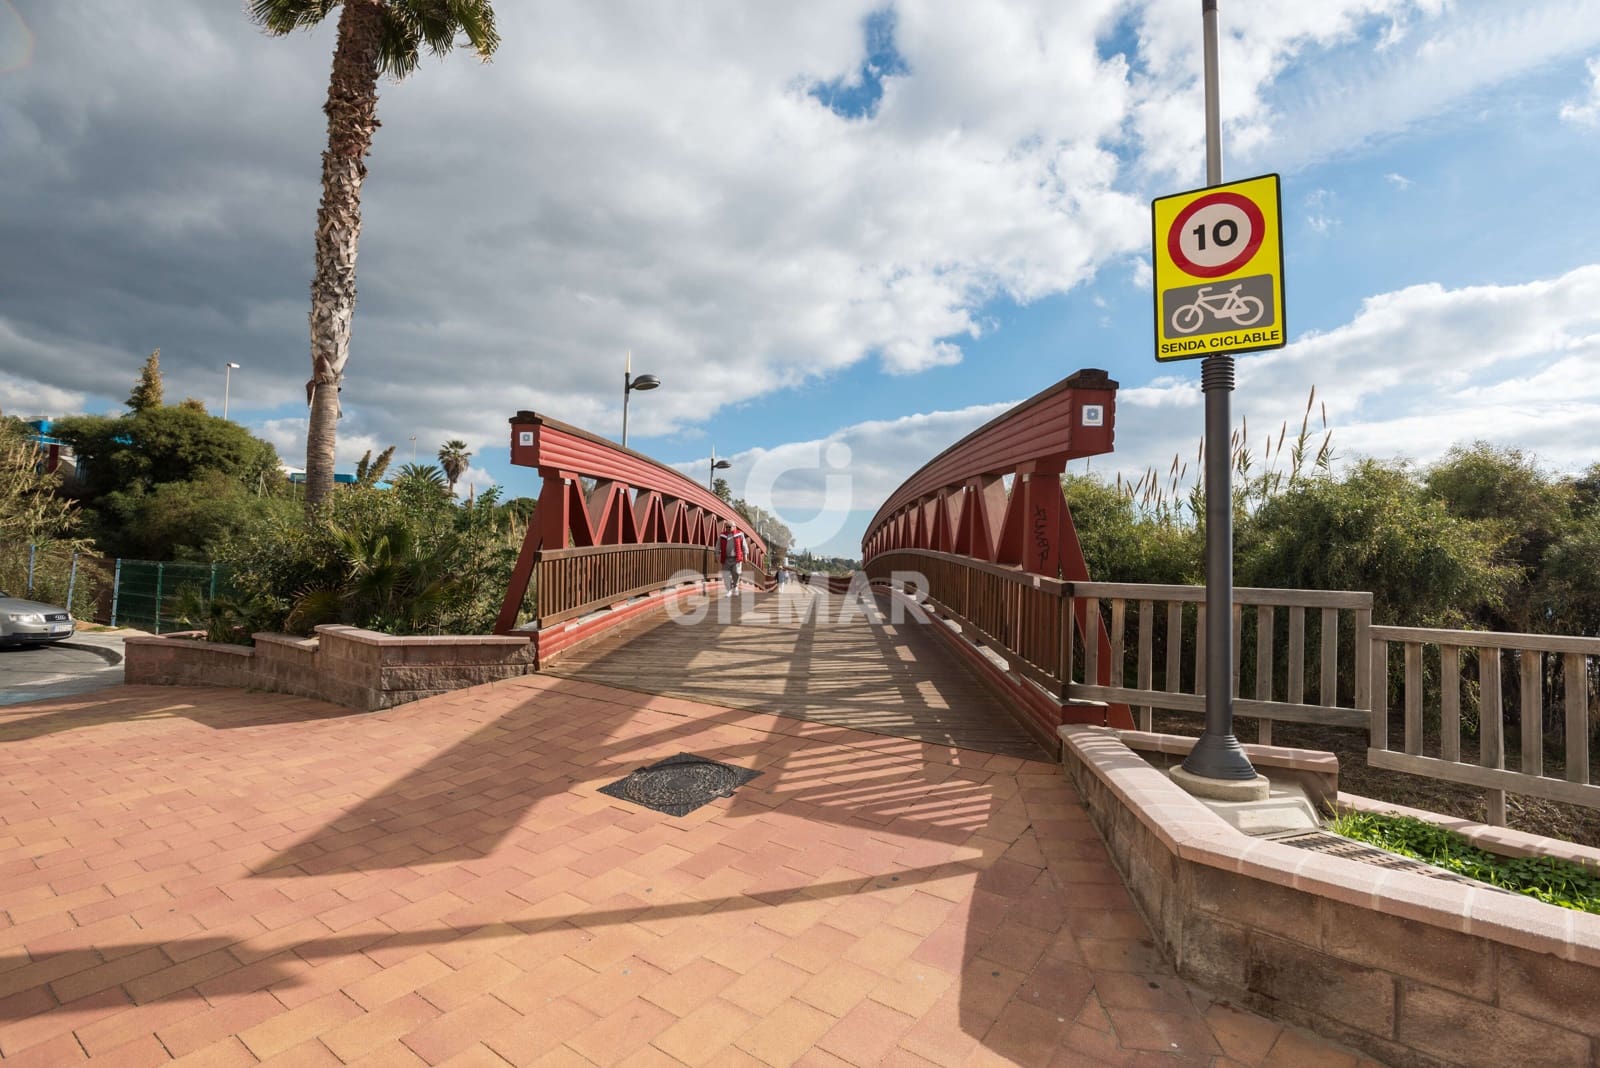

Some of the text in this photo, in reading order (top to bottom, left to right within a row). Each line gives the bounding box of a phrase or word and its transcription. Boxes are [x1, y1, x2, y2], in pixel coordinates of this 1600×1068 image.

[1193, 219, 1238, 251] 10
[1161, 331, 1279, 353] SENDA CICLABLE
